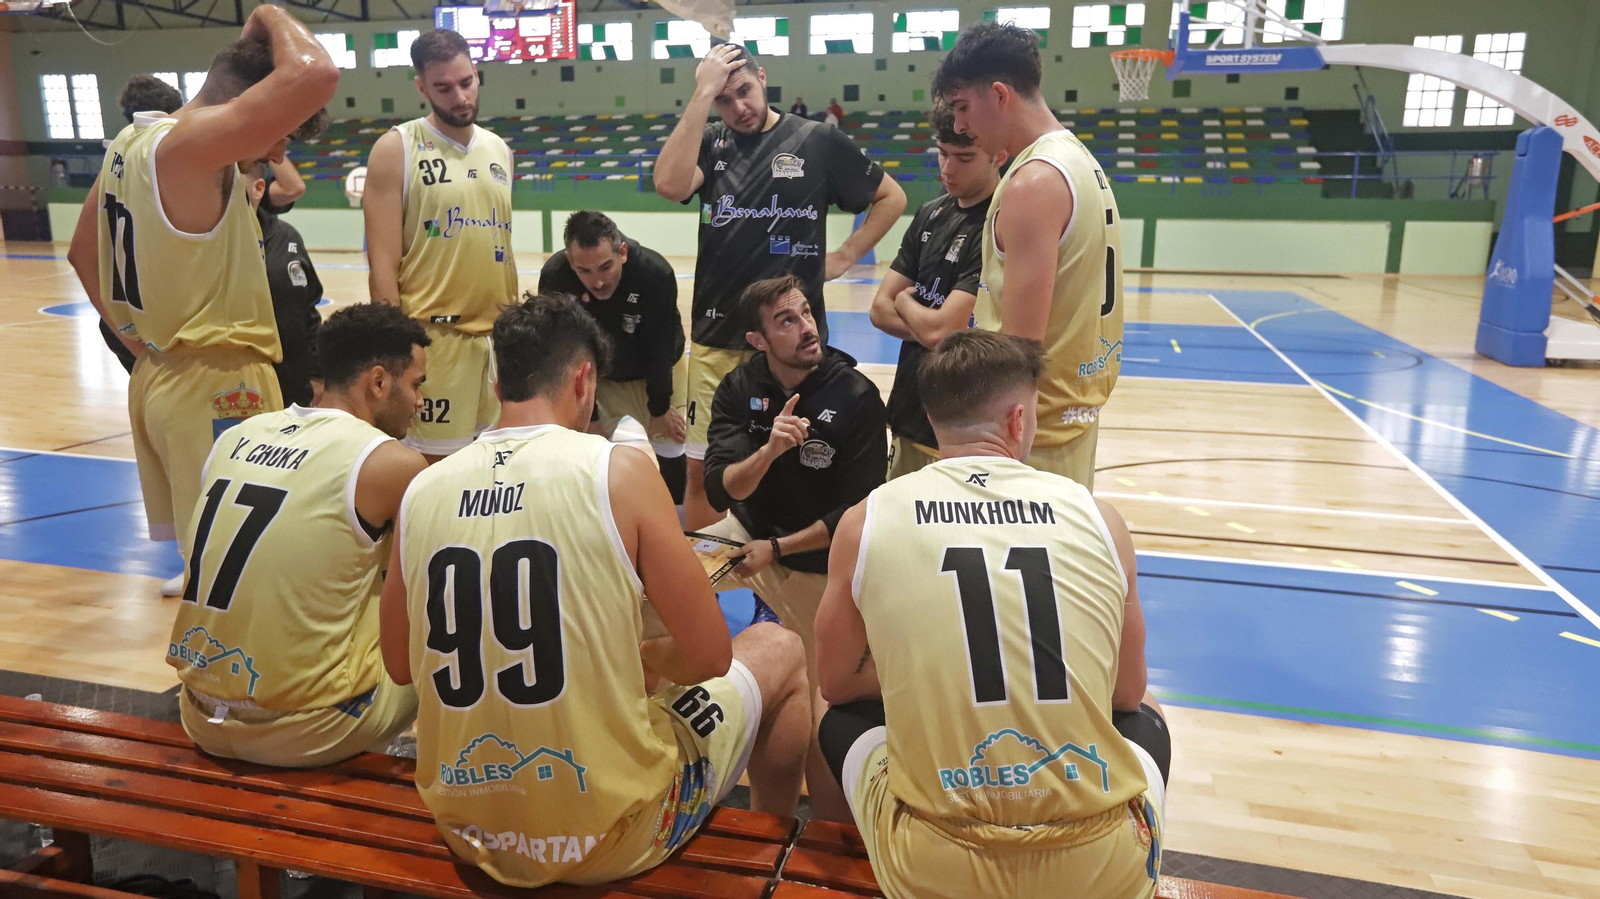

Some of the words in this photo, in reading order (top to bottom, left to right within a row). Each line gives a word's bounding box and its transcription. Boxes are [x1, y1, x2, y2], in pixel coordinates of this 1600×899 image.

[418, 158, 452, 186] 32
[420, 398, 451, 424] 32
[229, 437, 251, 460] V.
[245, 443, 310, 471] CHUKA
[458, 481, 525, 517] MUÑOZ
[915, 499, 1056, 525] MUNKHOLM
[182, 477, 291, 613] 17
[426, 538, 566, 710] 99
[938, 545, 1071, 706] 11
[440, 763, 514, 786] ROBLES
[938, 764, 1030, 790] ROBLES
